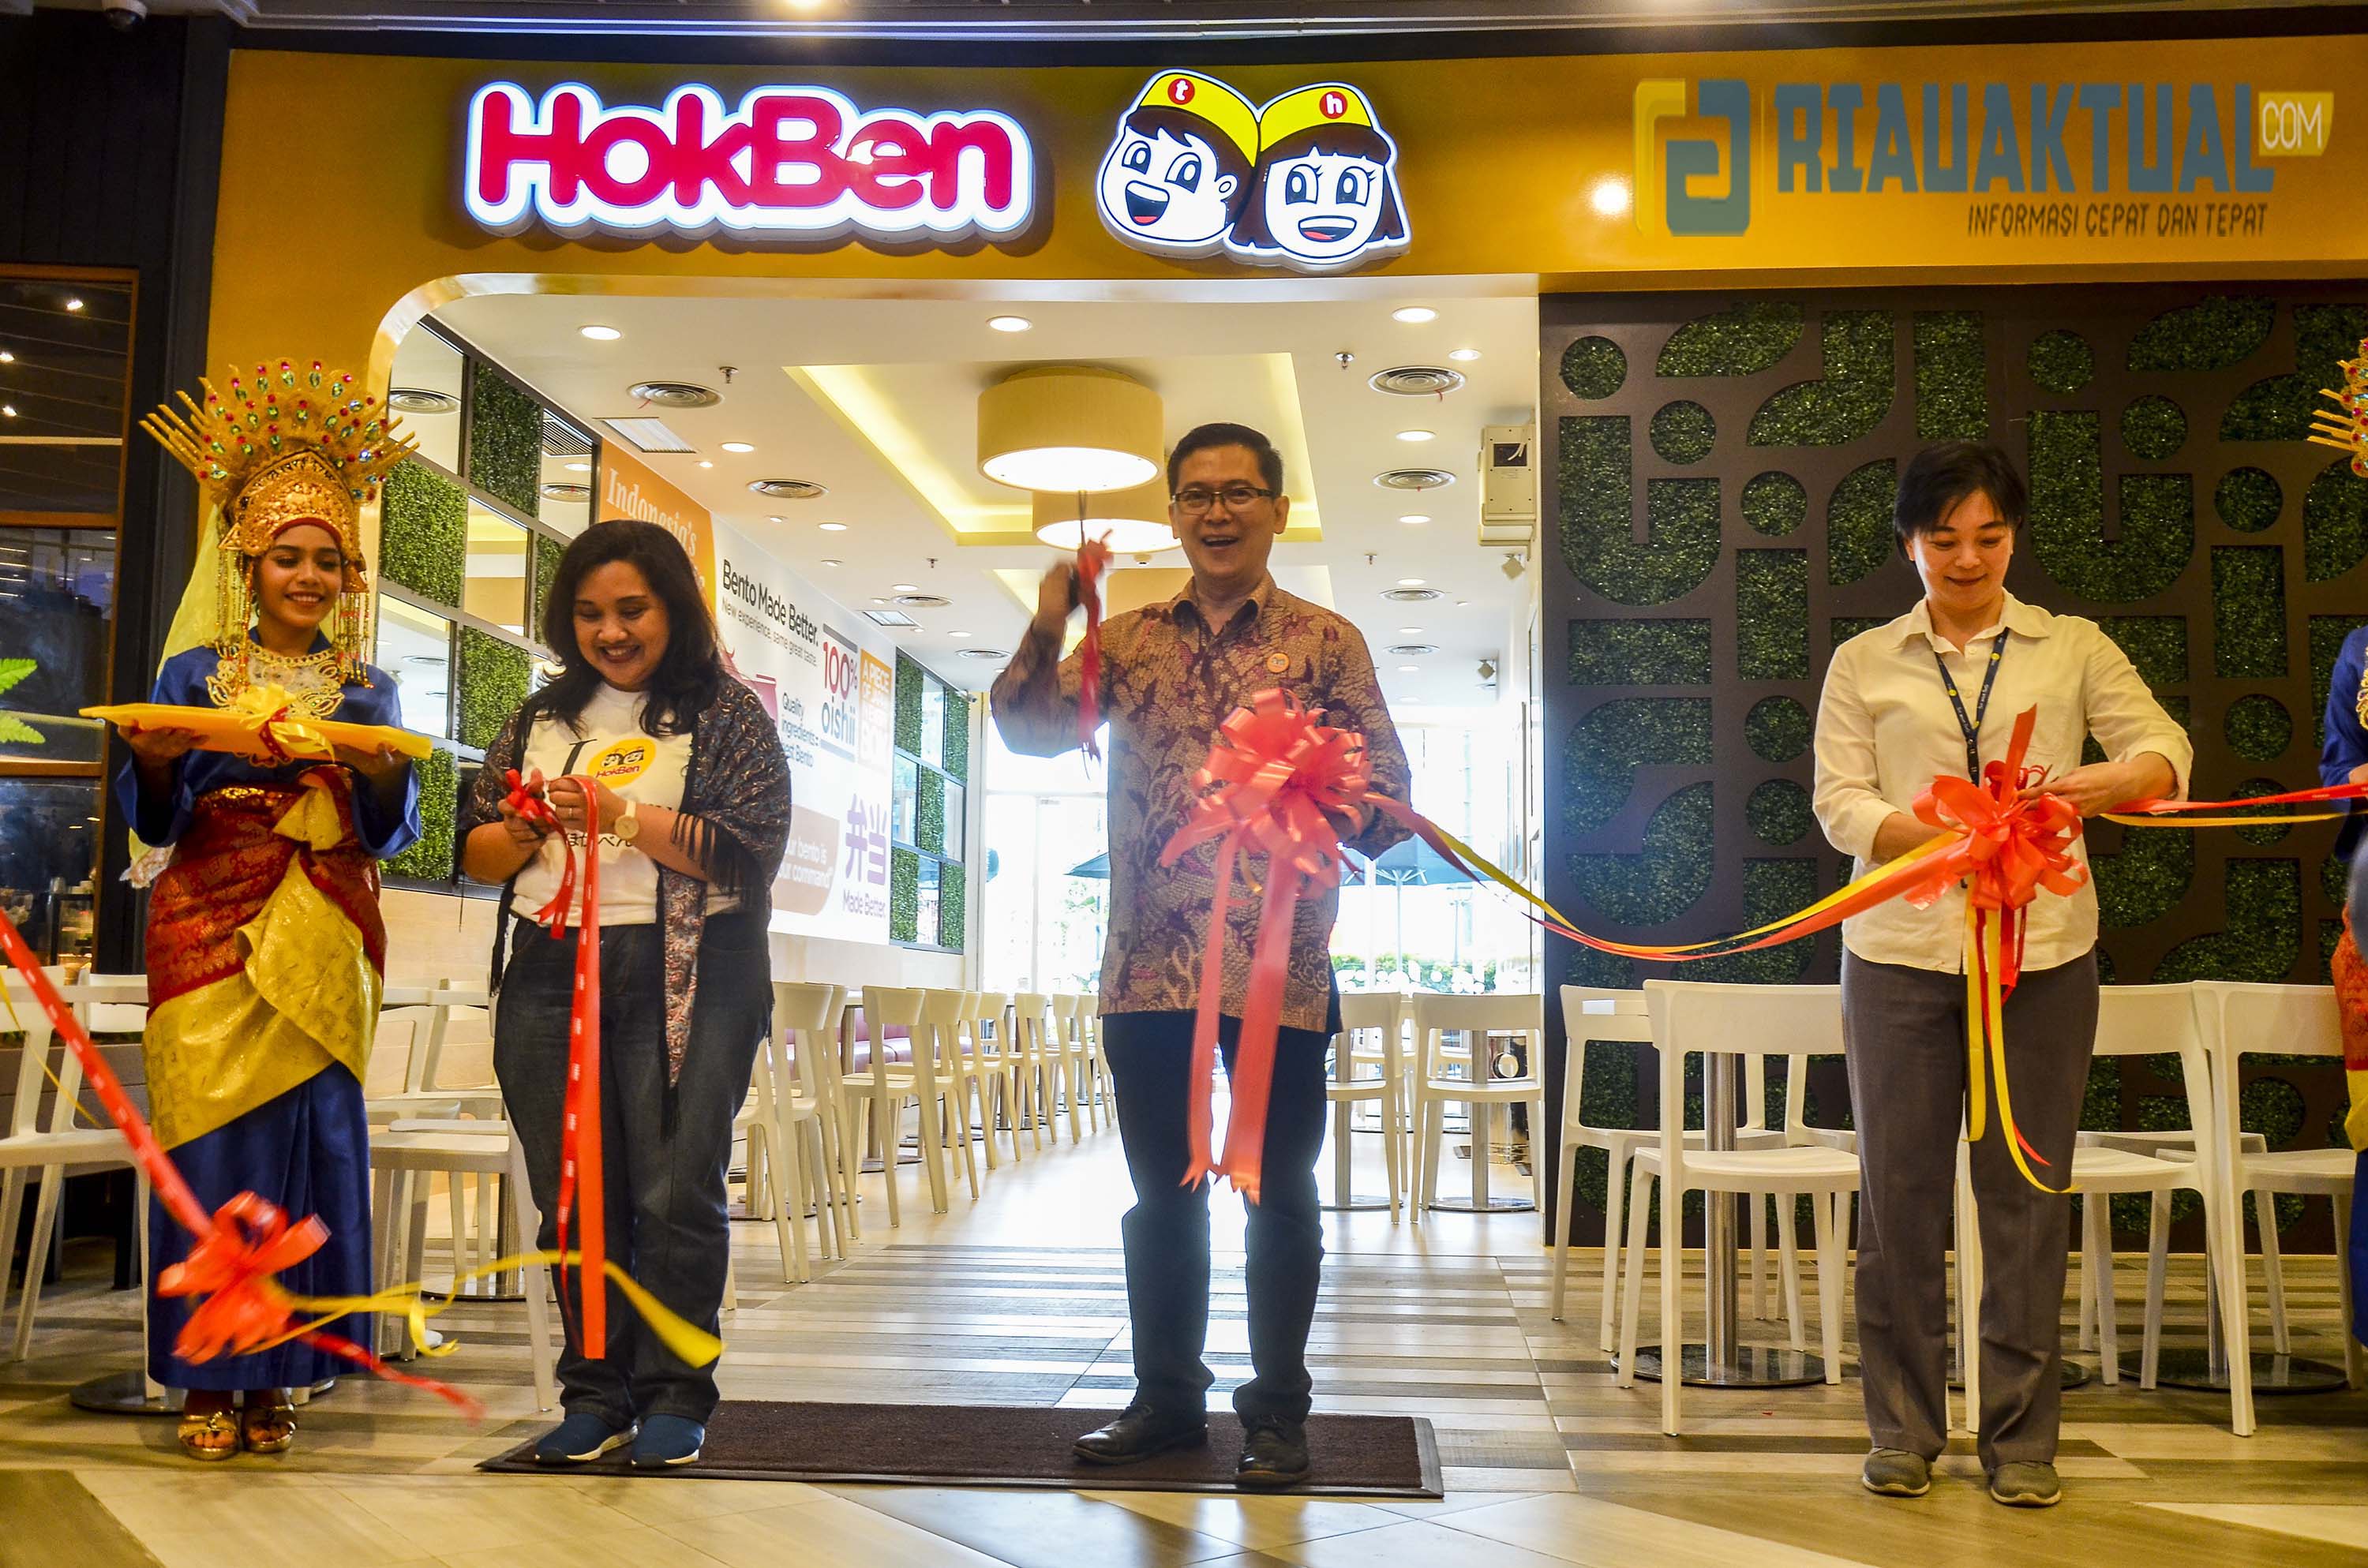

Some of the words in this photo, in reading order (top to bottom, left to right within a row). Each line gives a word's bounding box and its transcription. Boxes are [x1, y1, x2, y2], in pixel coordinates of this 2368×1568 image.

[1175, 79, 1190, 102] t
[1325, 92, 1344, 115] h
[478, 90, 1013, 210] HokBen
[722, 558, 757, 607] Bento
[758, 582, 787, 626] Made
[789, 603, 819, 647] Better.
[823, 642, 858, 701] 100%
